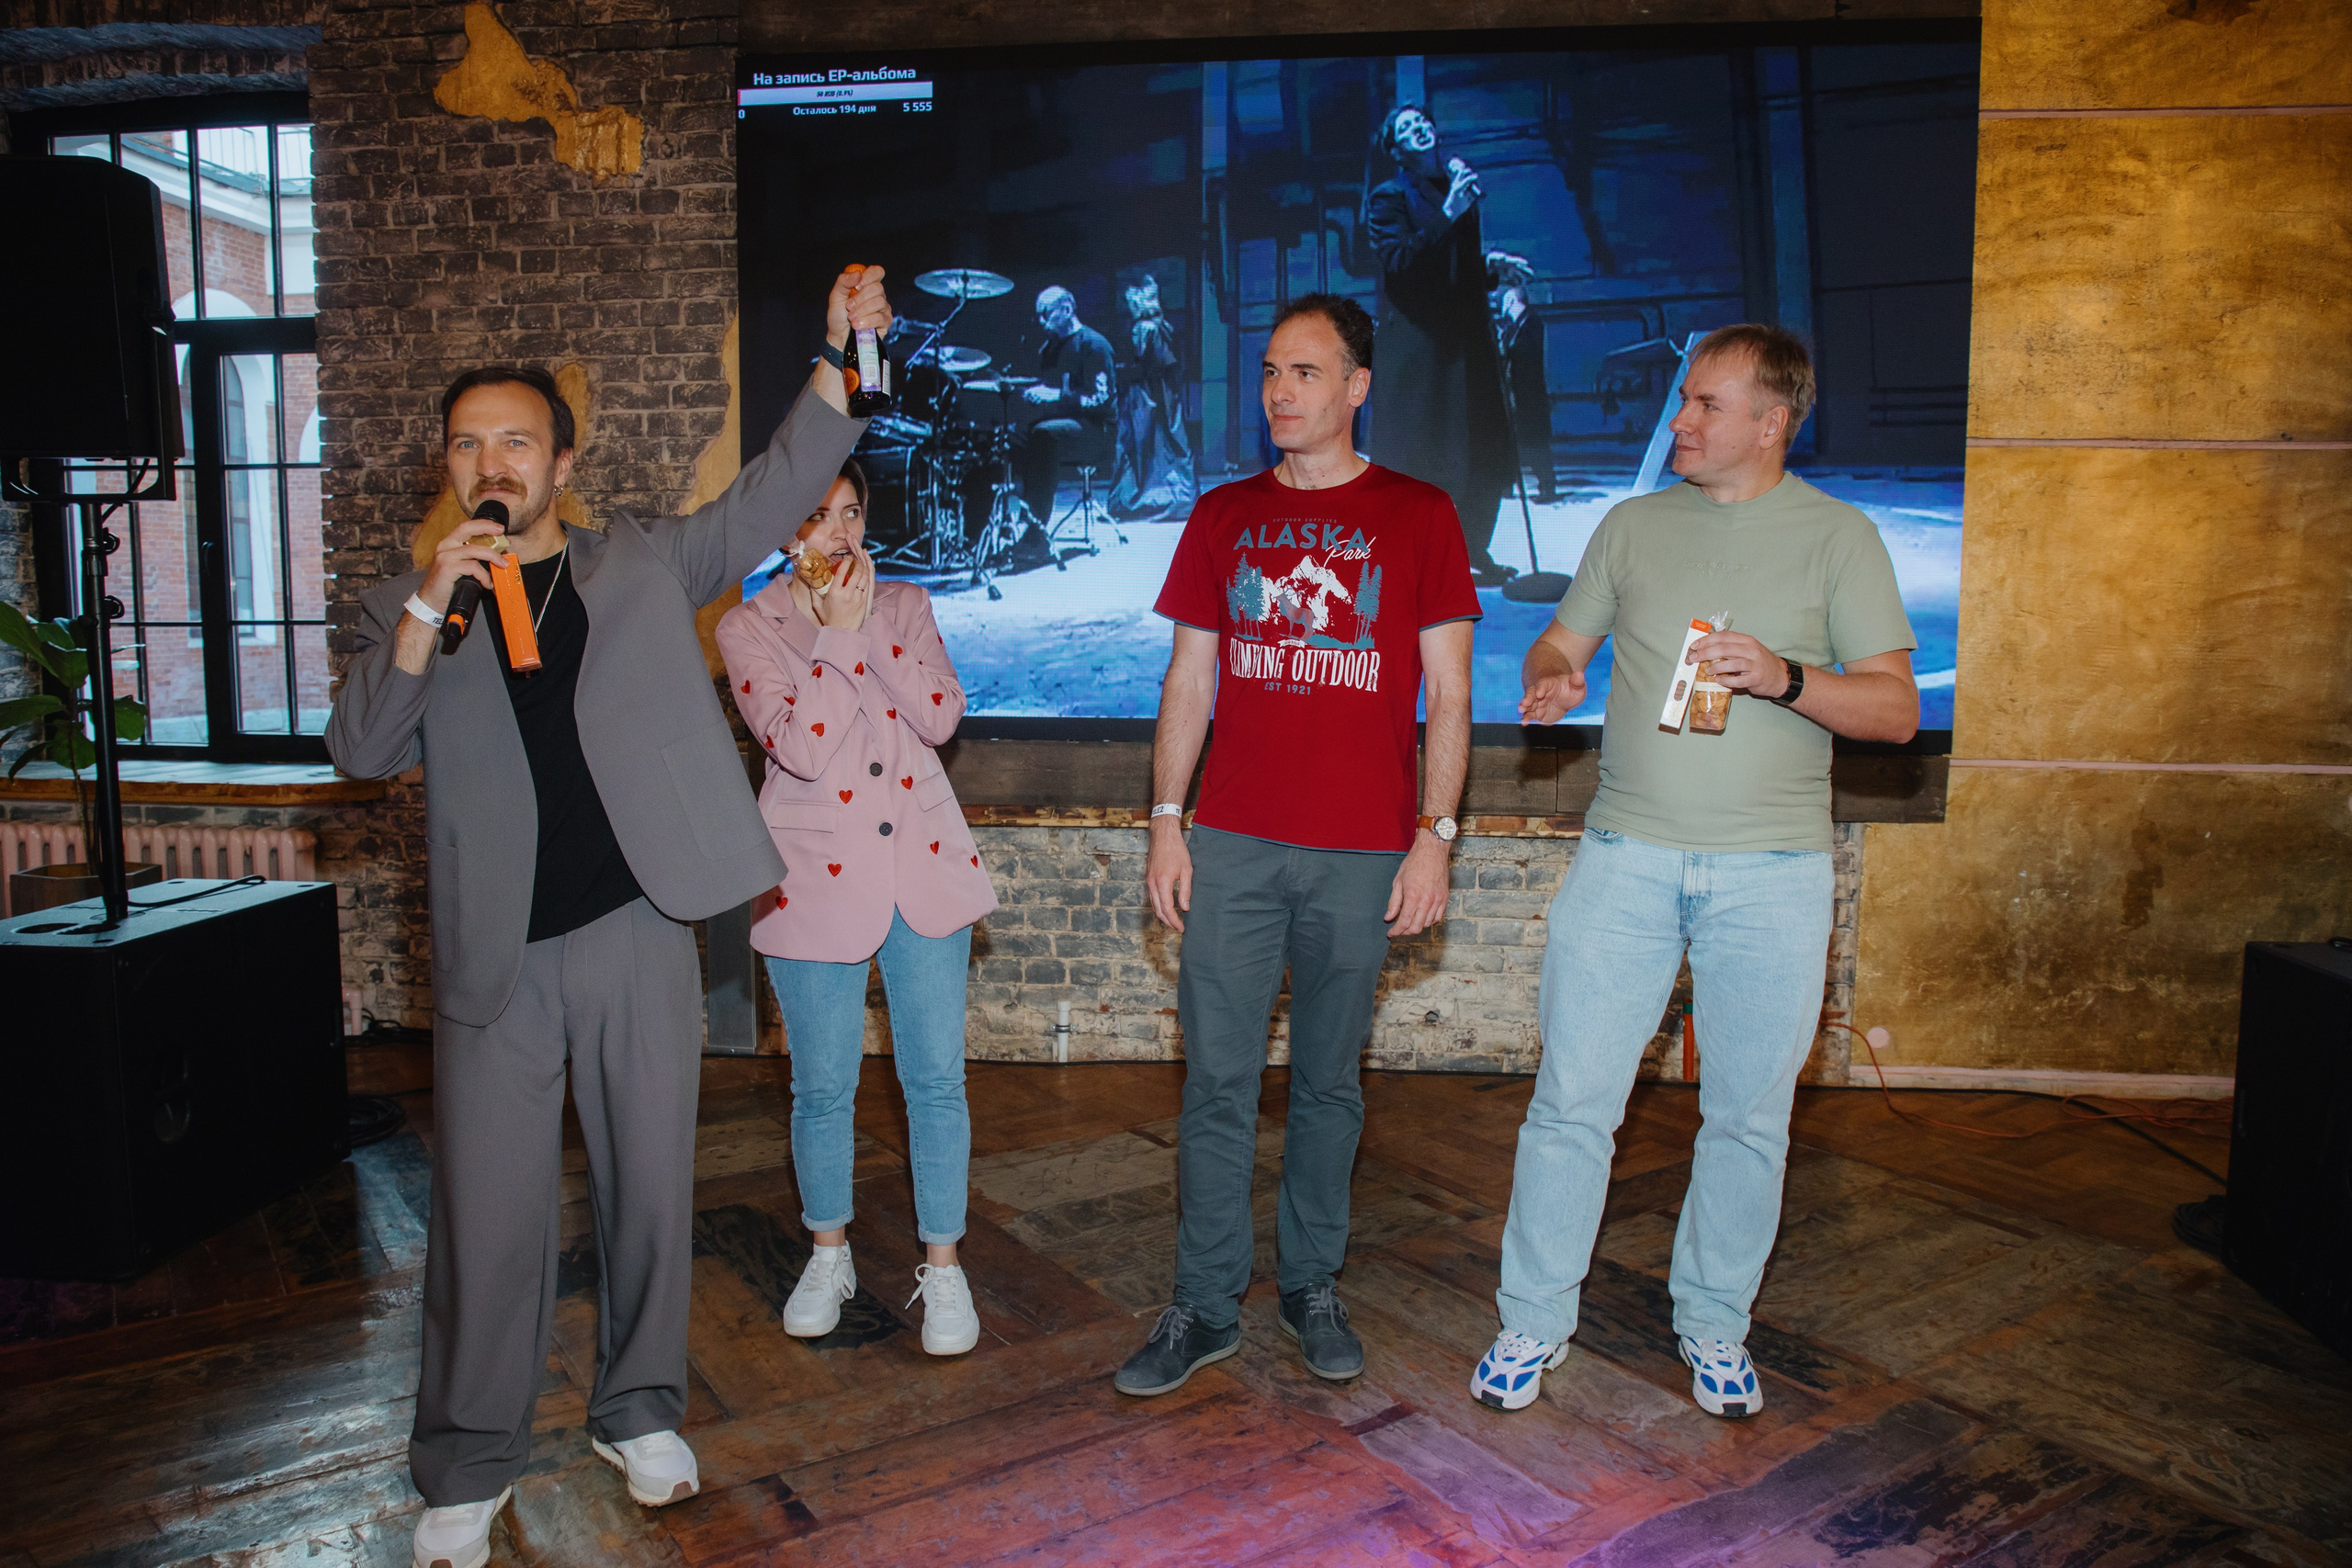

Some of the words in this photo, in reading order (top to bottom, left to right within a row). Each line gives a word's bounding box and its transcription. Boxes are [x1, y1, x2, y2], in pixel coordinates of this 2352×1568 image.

[753, 73, 773, 85] На
[775, 73, 825, 85] запись
[792, 106, 838, 116] Осталось
[839, 105, 856, 114] 194
[858, 105, 876, 115] дня
[903, 102, 910, 112] 5
[912, 101, 933, 111] 555
[738, 109, 746, 118] 0
[1233, 523, 1369, 551] ALASKA
[1324, 536, 1377, 568] Park
[1229, 637, 1286, 680] CLIMBING
[1291, 649, 1381, 693] OUTDOOR
[1264, 682, 1283, 692] EST
[1286, 683, 1312, 695] 1921
